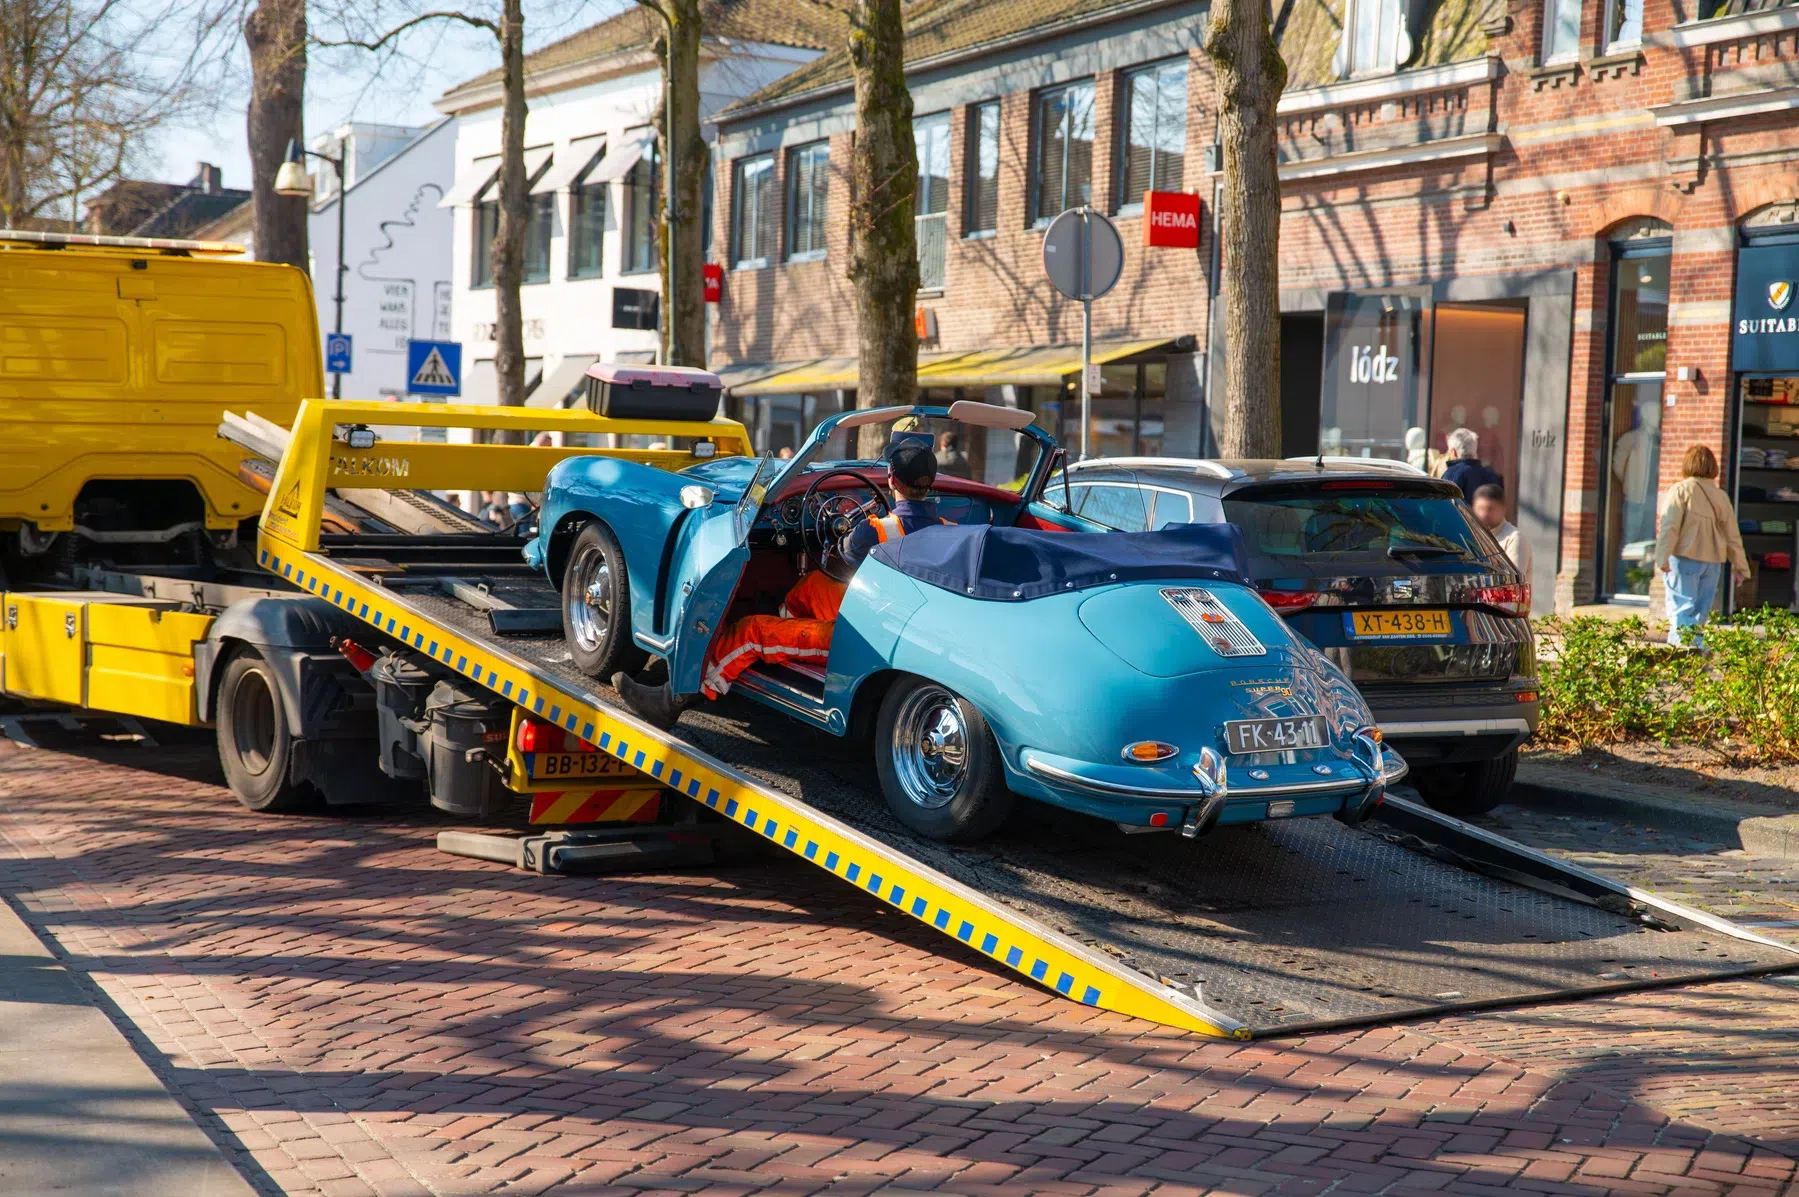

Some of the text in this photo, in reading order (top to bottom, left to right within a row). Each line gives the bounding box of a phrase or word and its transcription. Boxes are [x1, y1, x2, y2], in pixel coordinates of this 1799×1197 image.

[1151, 211, 1197, 228] HEMA
[1738, 317, 1799, 334] SUITAB
[1637, 332, 1667, 341] SUITABLE
[1350, 345, 1399, 384] lódz
[1531, 430, 1557, 448] lódz
[330, 456, 409, 477] ALKOM
[1361, 613, 1445, 632] XT-438-H
[1230, 678, 1290, 687] PORSCHE
[1245, 685, 1293, 697] SUPER 90
[1238, 720, 1317, 749] FK-43-11
